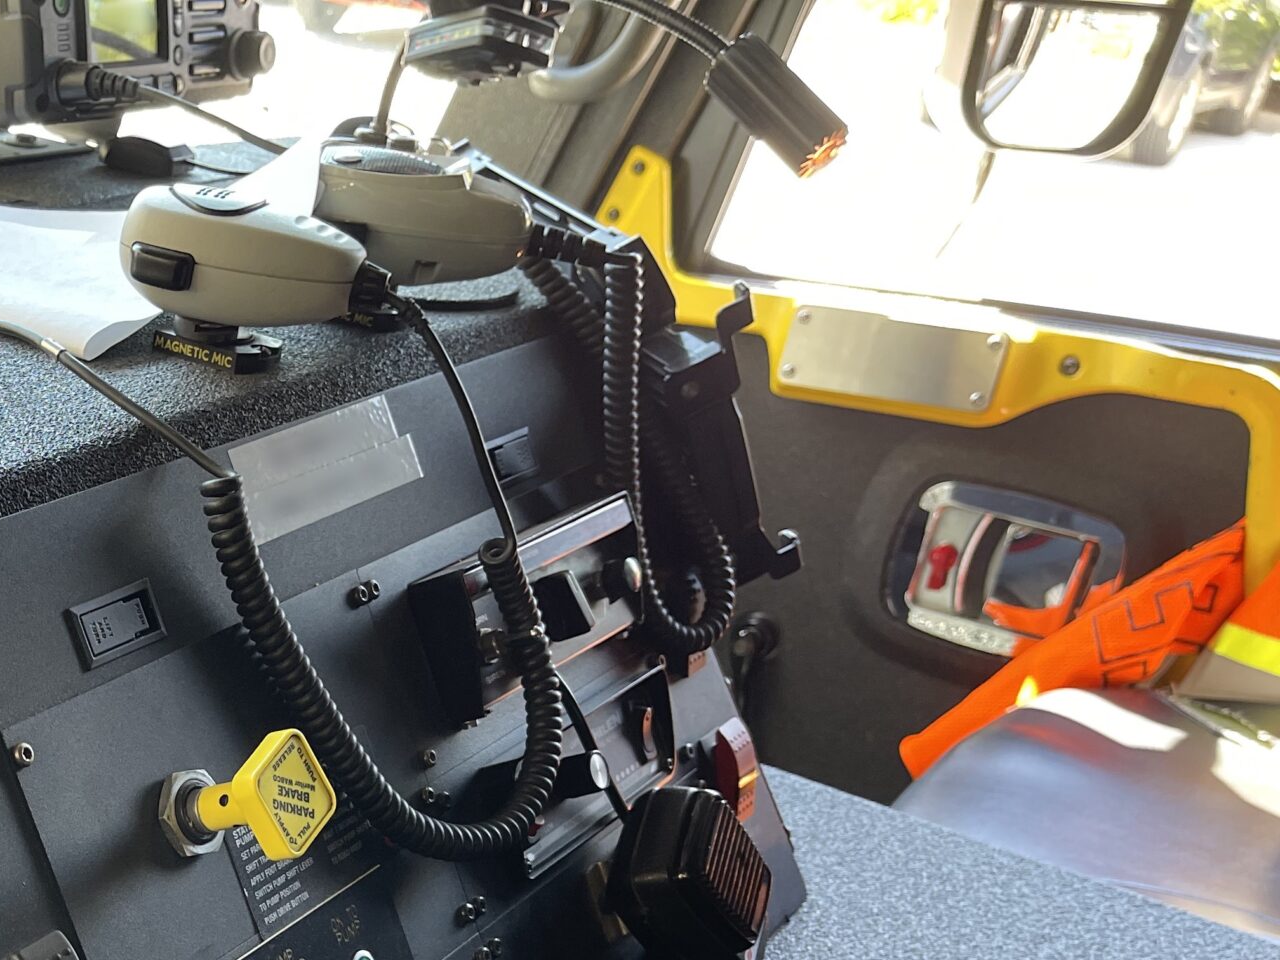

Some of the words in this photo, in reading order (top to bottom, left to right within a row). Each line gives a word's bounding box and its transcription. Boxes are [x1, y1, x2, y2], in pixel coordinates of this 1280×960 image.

[154, 335, 210, 362] MAGNETIC
[211, 351, 233, 369] MIC
[272, 742, 296, 772] RELEASE
[296, 746, 305, 760] TO
[272, 774, 294, 787] WABCO
[303, 759, 318, 782] PUSH
[277, 784, 310, 803] BRAKE
[272, 798, 315, 820] PARKING
[273, 811, 291, 838] APPLY
[297, 821, 312, 839] PULL
[288, 836, 298, 845] TO
[241, 848, 252, 861] SET
[250, 871, 266, 887] APPLY
[254, 882, 274, 900] SWITCH
[272, 873, 287, 888] PUMP
[285, 865, 300, 880] SHIFT
[259, 902, 268, 913] TO
[266, 893, 280, 908] PUMP
[279, 879, 302, 900] POSITION
[263, 910, 279, 925] PUSH
[276, 902, 293, 918] DRIVE
[290, 891, 310, 908] BUTTON
